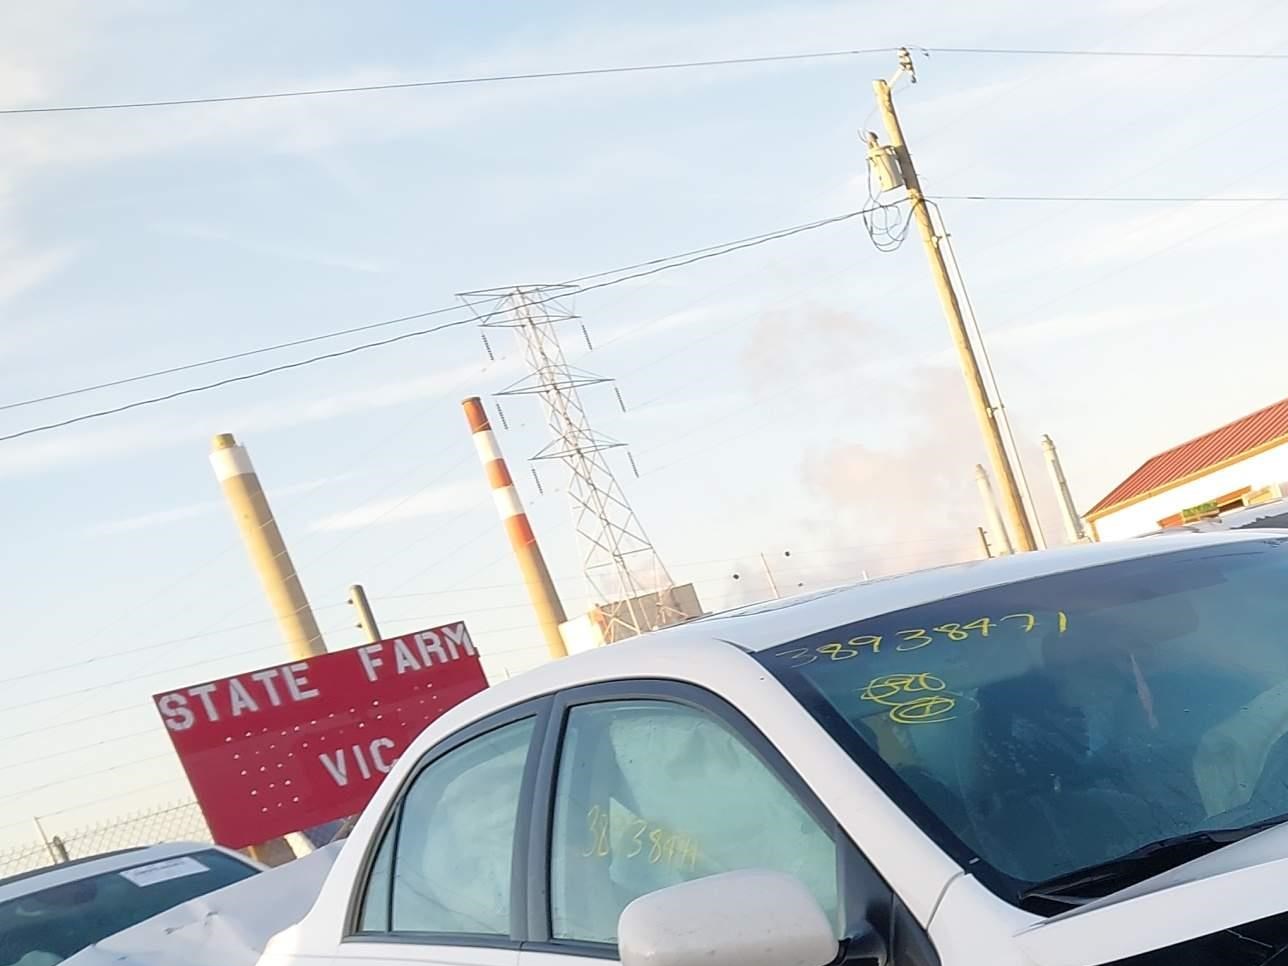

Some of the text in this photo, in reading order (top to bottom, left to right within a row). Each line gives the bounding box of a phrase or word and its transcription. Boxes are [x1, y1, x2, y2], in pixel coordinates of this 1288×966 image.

[775, 611, 1068, 669] 38938471
[158, 622, 478, 731] STATE FARM
[319, 737, 398, 787] VIC
